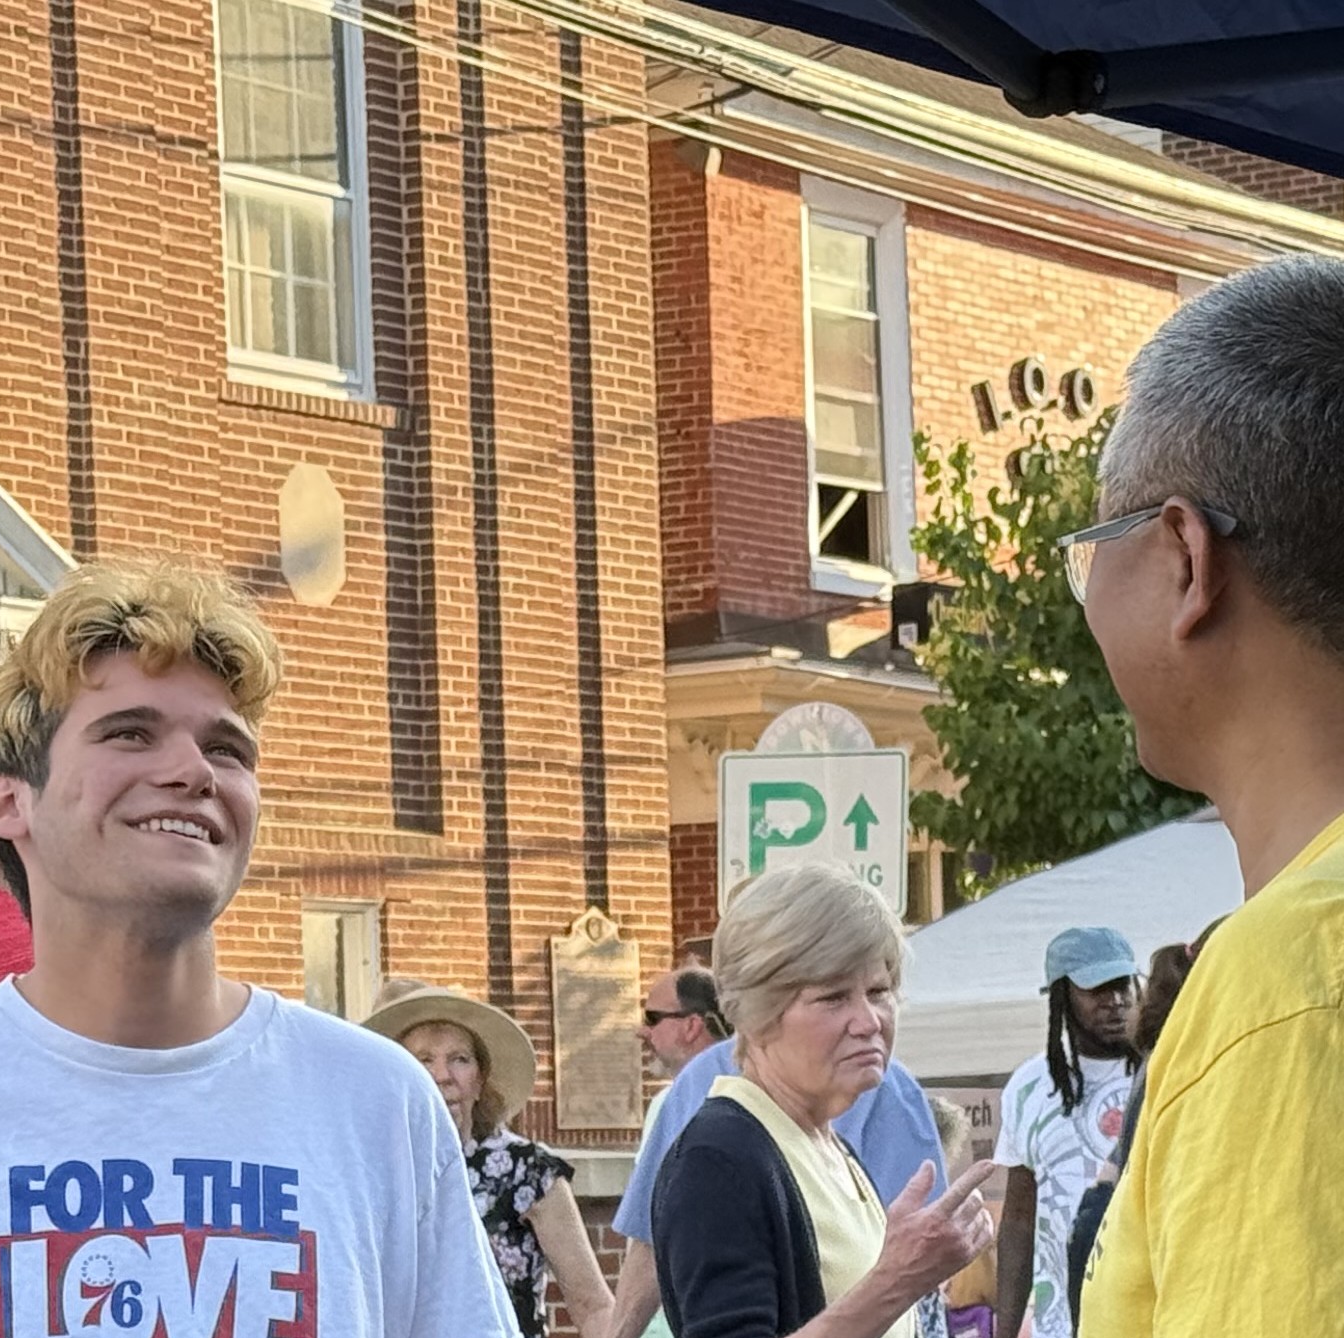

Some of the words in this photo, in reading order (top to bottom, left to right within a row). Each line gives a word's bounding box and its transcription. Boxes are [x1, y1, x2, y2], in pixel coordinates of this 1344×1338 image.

[749, 782, 826, 877] P
[8, 1158, 154, 1235] FOR
[173, 1157, 299, 1237] THE
[81, 1277, 143, 1328] 76
